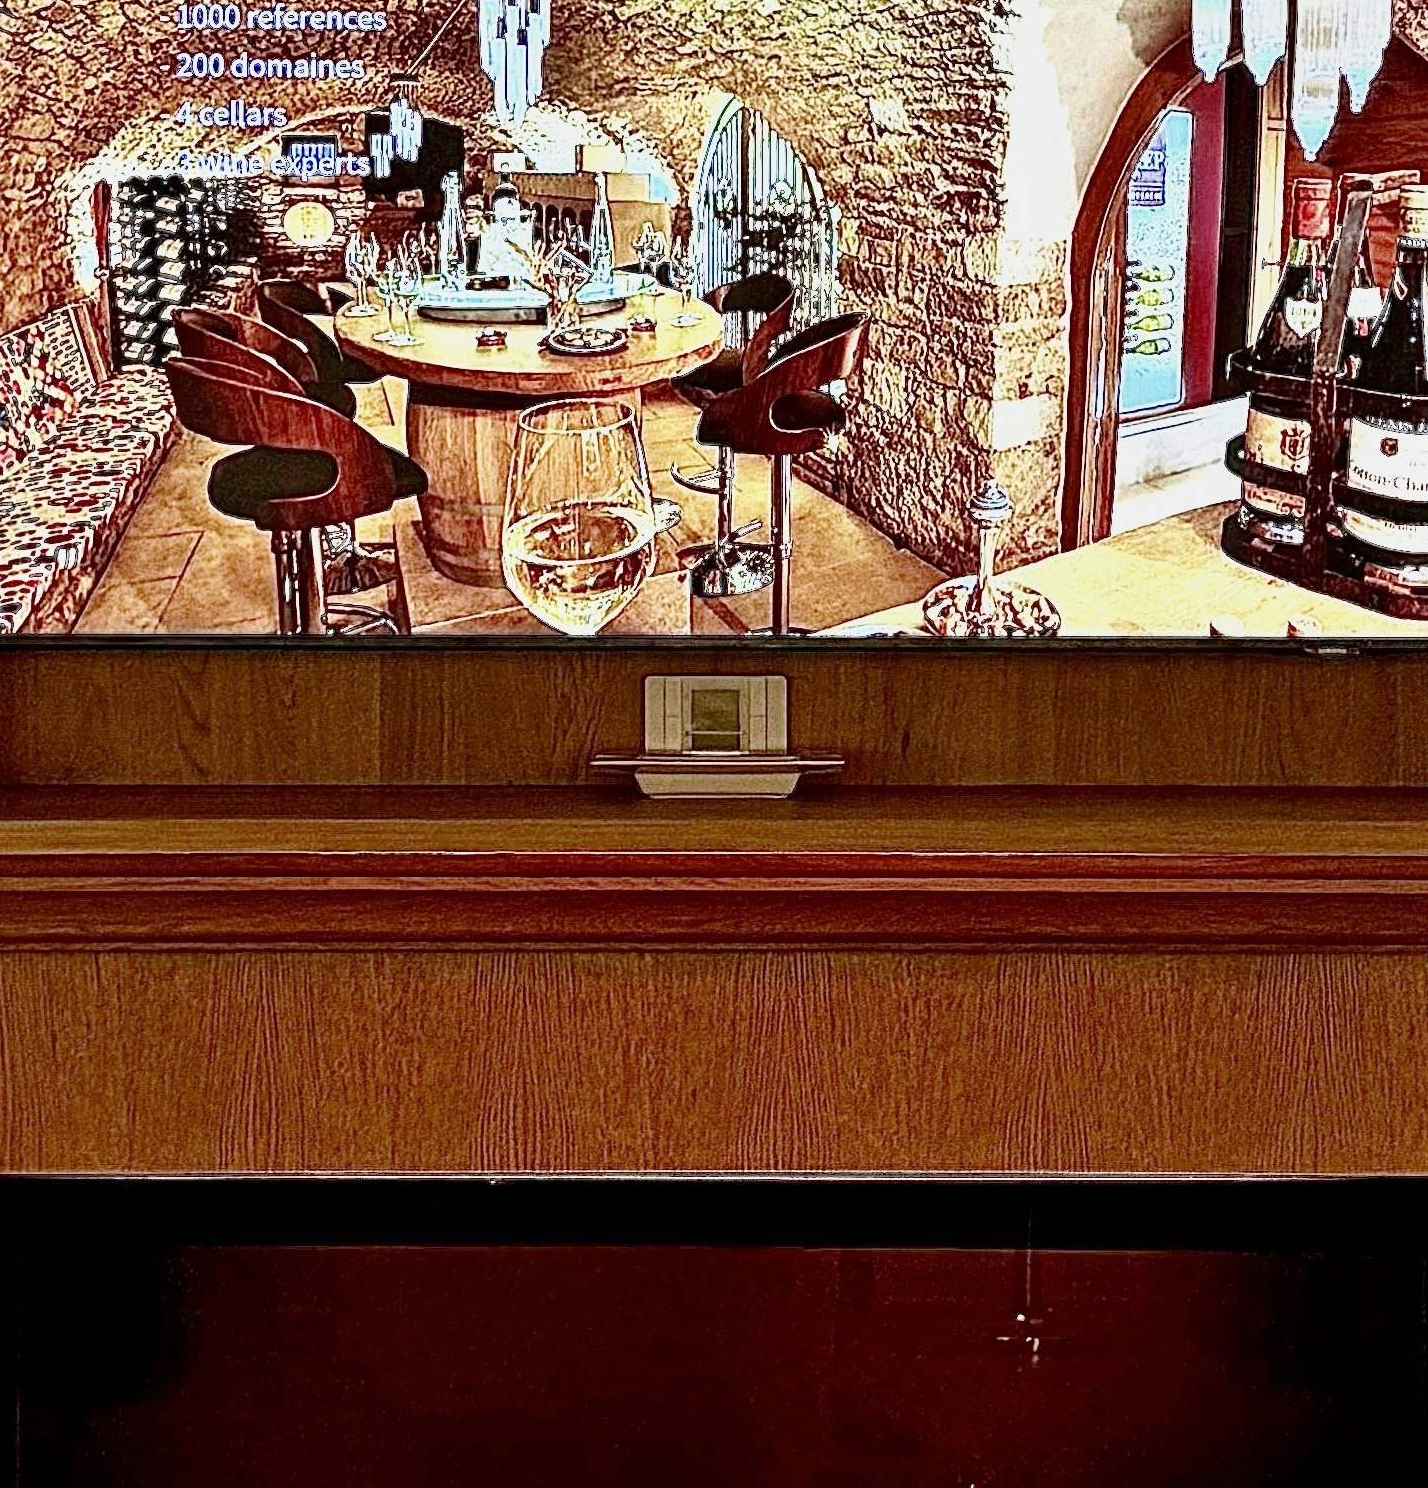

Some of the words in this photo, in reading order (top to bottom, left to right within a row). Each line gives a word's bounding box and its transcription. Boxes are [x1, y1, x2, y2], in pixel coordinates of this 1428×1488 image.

[176, 2, 241, 31] 1000
[246, 2, 388, 32] references
[175, 51, 225, 79] 200
[230, 51, 365, 79] domaines
[175, 100, 193, 126] 4
[198, 98, 289, 128] cellars
[197, 151, 264, 175] wine
[268, 153, 372, 182] experts
